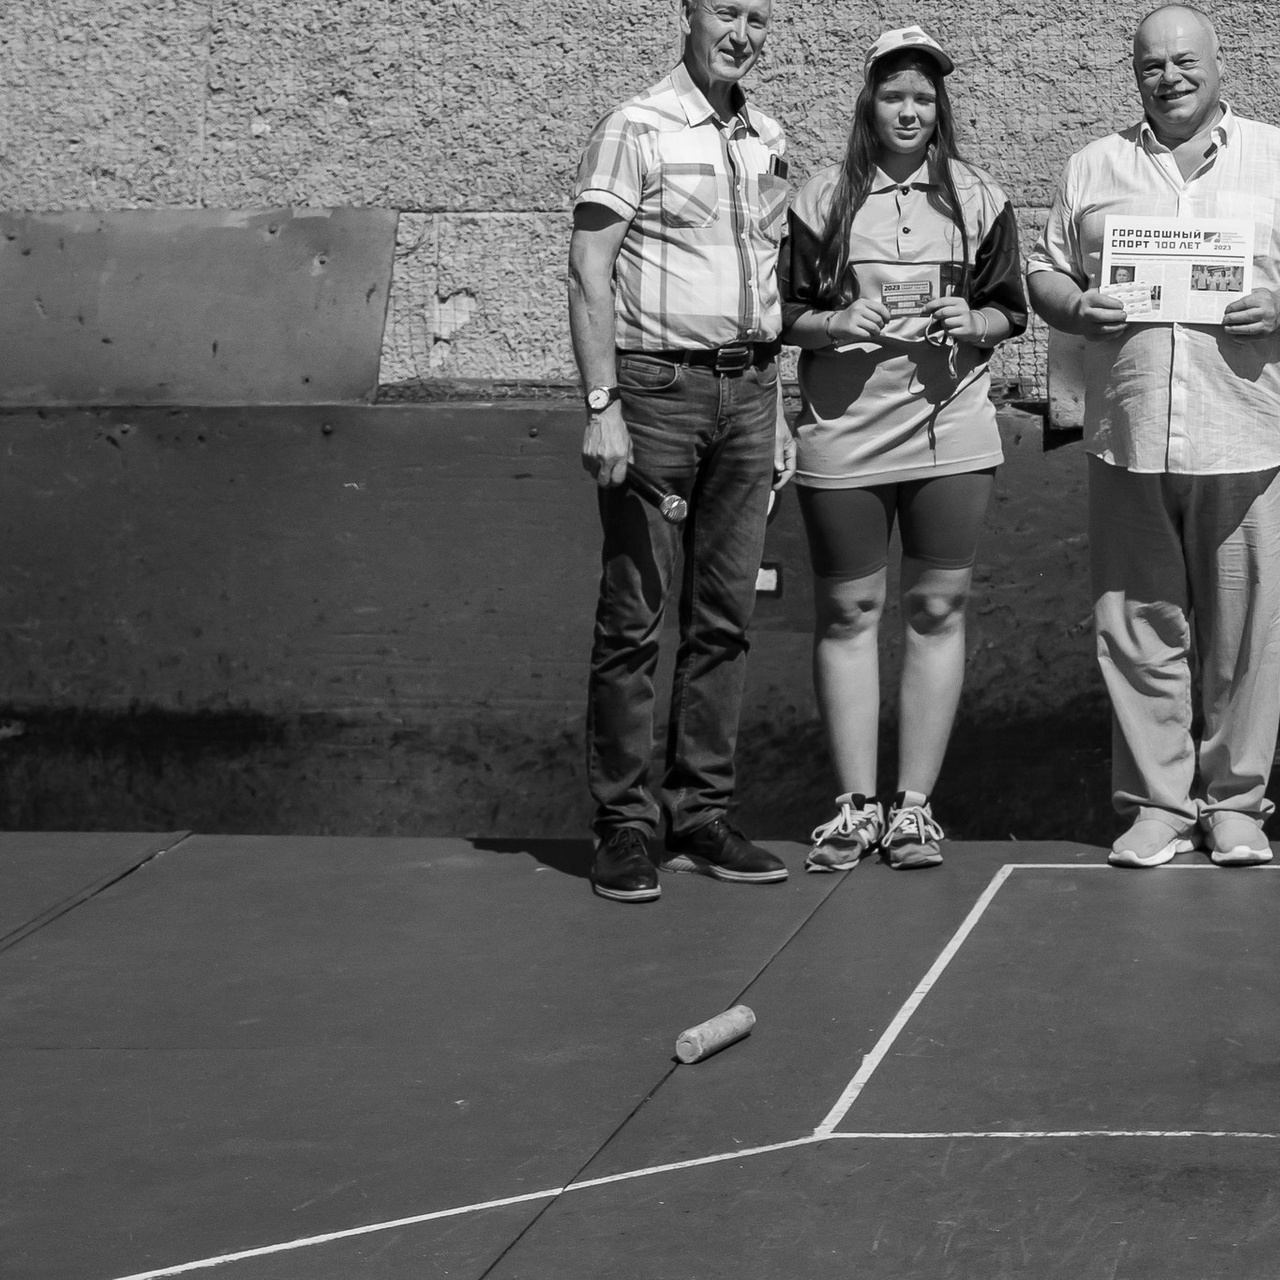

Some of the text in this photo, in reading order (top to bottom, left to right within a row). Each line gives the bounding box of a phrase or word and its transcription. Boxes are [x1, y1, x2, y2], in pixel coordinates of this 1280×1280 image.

[1112, 228, 1201, 239] ГОРОДОШНЫЙ
[1111, 240, 1201, 250] СПОРТ 100 ЛЕТ
